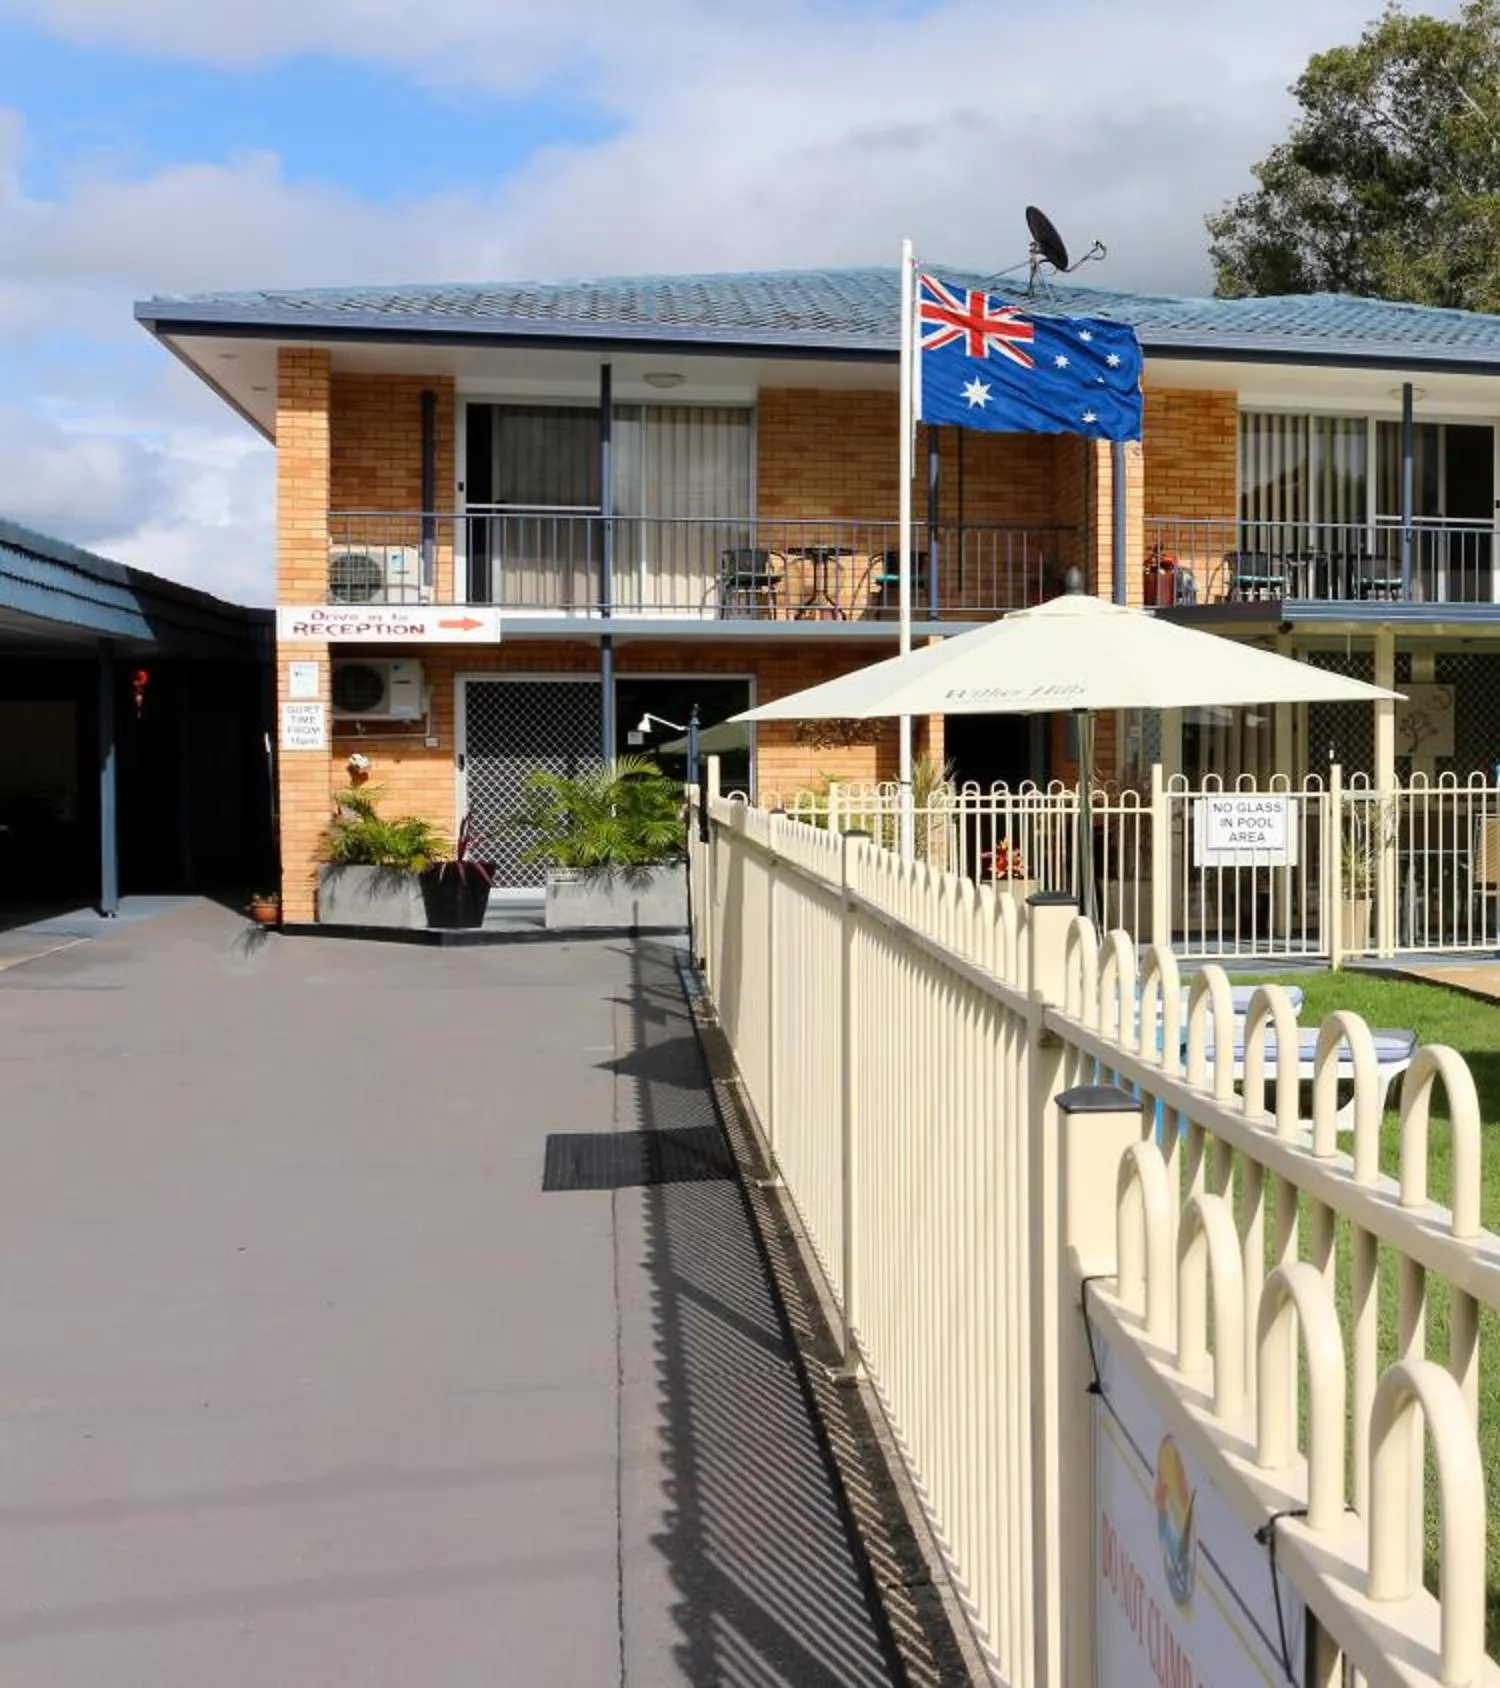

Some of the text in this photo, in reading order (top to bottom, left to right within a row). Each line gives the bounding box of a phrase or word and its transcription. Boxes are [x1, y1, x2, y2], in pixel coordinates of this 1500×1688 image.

[292, 623, 426, 636] RECEPTION
[287, 726, 321, 735] FROM
[1212, 802, 1282, 813] NO GLASS
[1219, 817, 1274, 828] IN POOL
[1228, 831, 1266, 842] AREA
